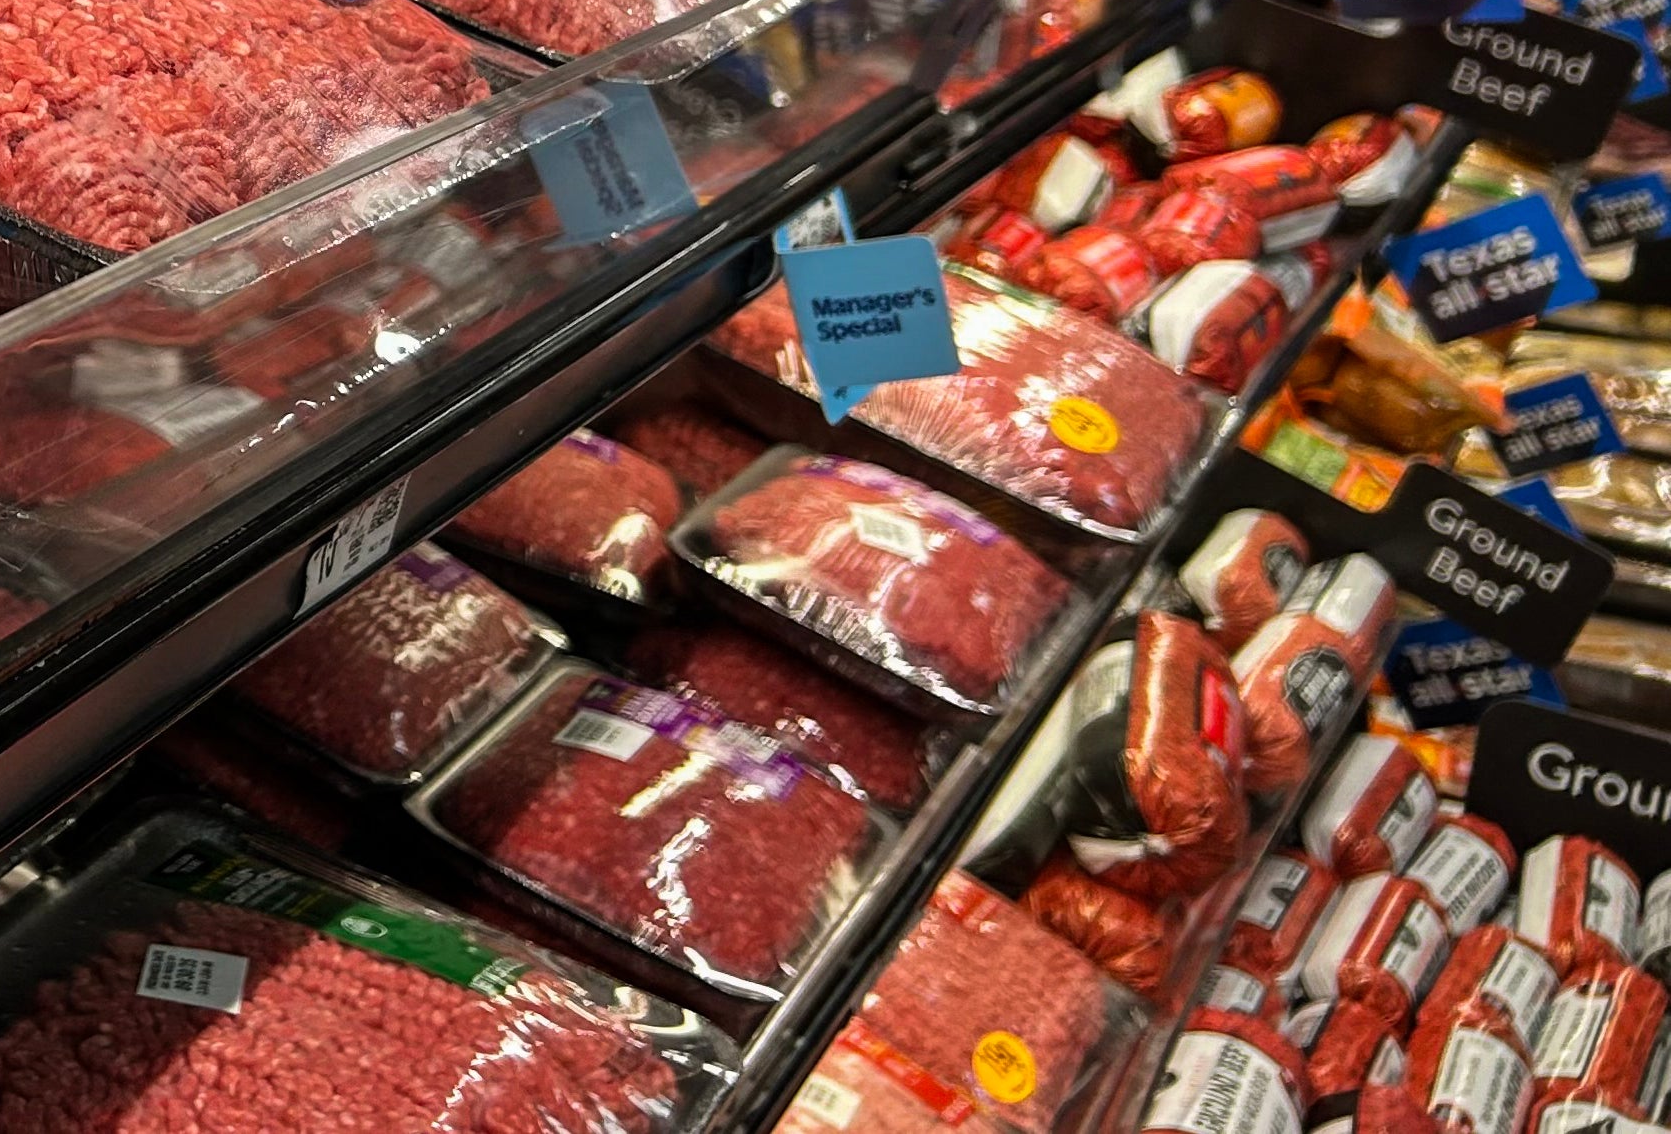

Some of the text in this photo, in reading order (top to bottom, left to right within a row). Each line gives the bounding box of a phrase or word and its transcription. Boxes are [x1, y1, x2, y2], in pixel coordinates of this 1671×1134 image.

[1442, 20, 1596, 86] Ground
[1448, 59, 1552, 118] Beef
[1420, 225, 1538, 283] Texas
[811, 286, 937, 319] Manager's
[1430, 253, 1561, 320] all star
[816, 314, 903, 345] Special
[1504, 417, 1602, 465] all star
[1425, 497, 1571, 593] Ground
[1423, 547, 1529, 616] Beef
[1402, 637, 1513, 674] Texas
[1458, 663, 1534, 701] star
